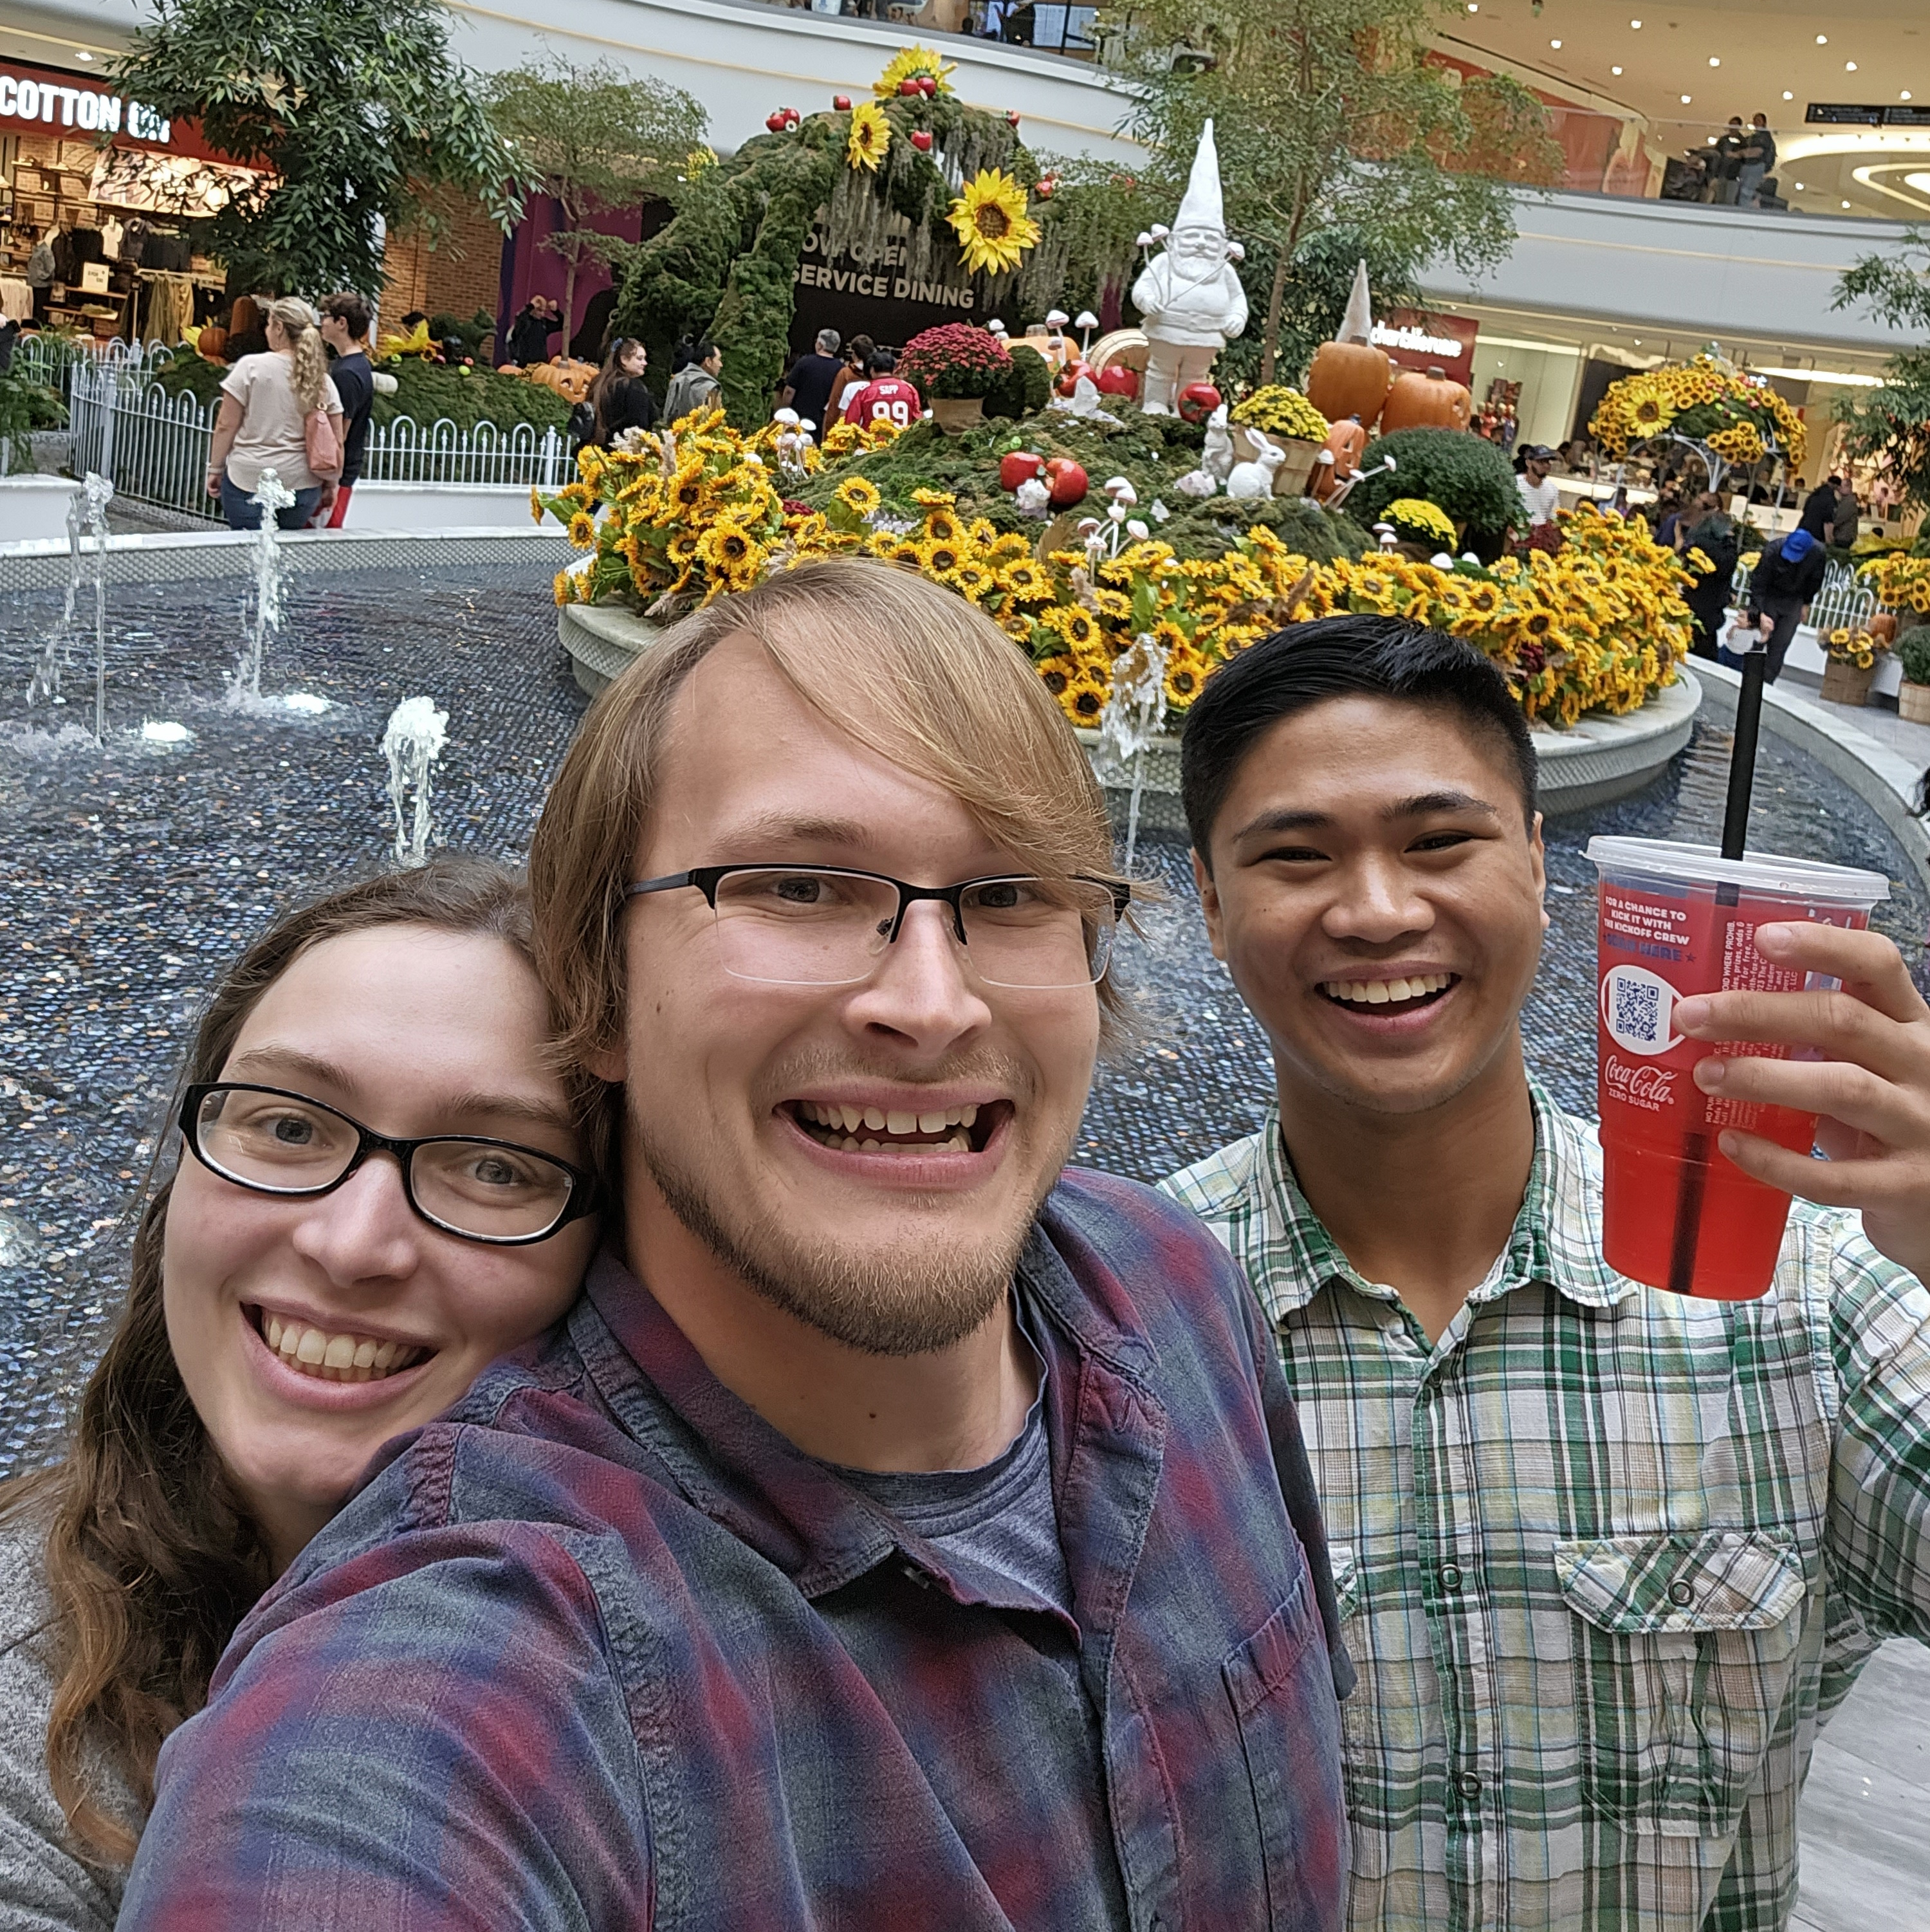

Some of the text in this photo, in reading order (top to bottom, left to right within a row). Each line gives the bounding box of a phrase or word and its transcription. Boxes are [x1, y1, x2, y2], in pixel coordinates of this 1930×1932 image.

[0, 75, 121, 133] COTTON
[802, 232, 844, 257] OW
[894, 277, 975, 309] DINING
[879, 384, 899, 395] SAPP
[872, 401, 908, 430] 99
[1605, 896, 1686, 921] FOR A CHANCE TO
[1611, 909, 1671, 930] KICK IT WITH
[1604, 918, 1690, 945] THE KICKOFF CREW
[1640, 941, 1682, 962] HERE
[1731, 975, 1740, 991] ules,
[1736, 929, 1744, 947] odds
[1740, 966, 1749, 979] for
[1745, 923, 1754, 940] visit
[1723, 951, 1732, 977] WHERE
[1758, 966, 1767, 978] The
[1722, 977, 1731, 991] OID
[1765, 964, 1775, 990] tradem
[1609, 1087, 1660, 1112] ZERO SUGAR
[1706, 1097, 1714, 1110] PUR
